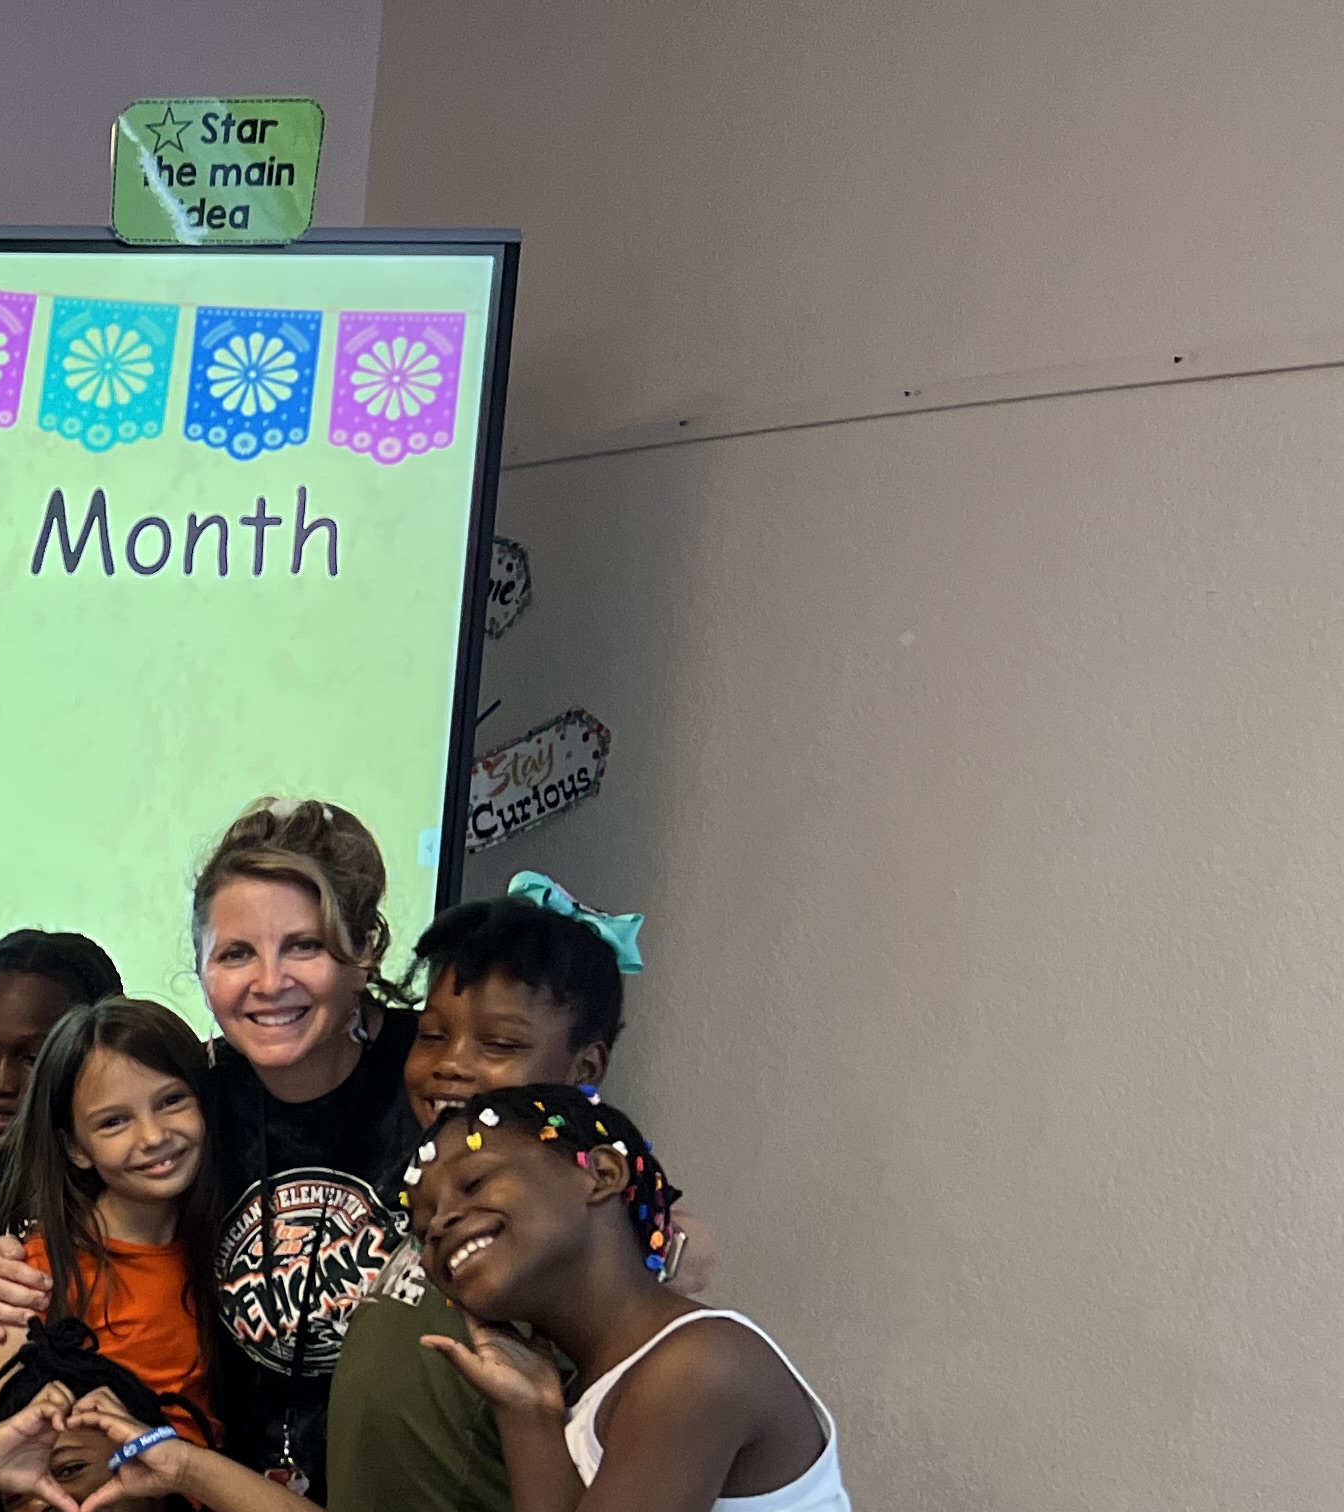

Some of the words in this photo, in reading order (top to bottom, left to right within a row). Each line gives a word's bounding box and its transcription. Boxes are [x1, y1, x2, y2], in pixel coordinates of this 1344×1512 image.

[200, 112, 279, 145] Star
[142, 156, 197, 187] he
[209, 156, 296, 187] main
[178, 198, 250, 230] dea
[29, 487, 340, 578] Month
[487, 742, 554, 798] Stay
[472, 767, 592, 839] Curious
